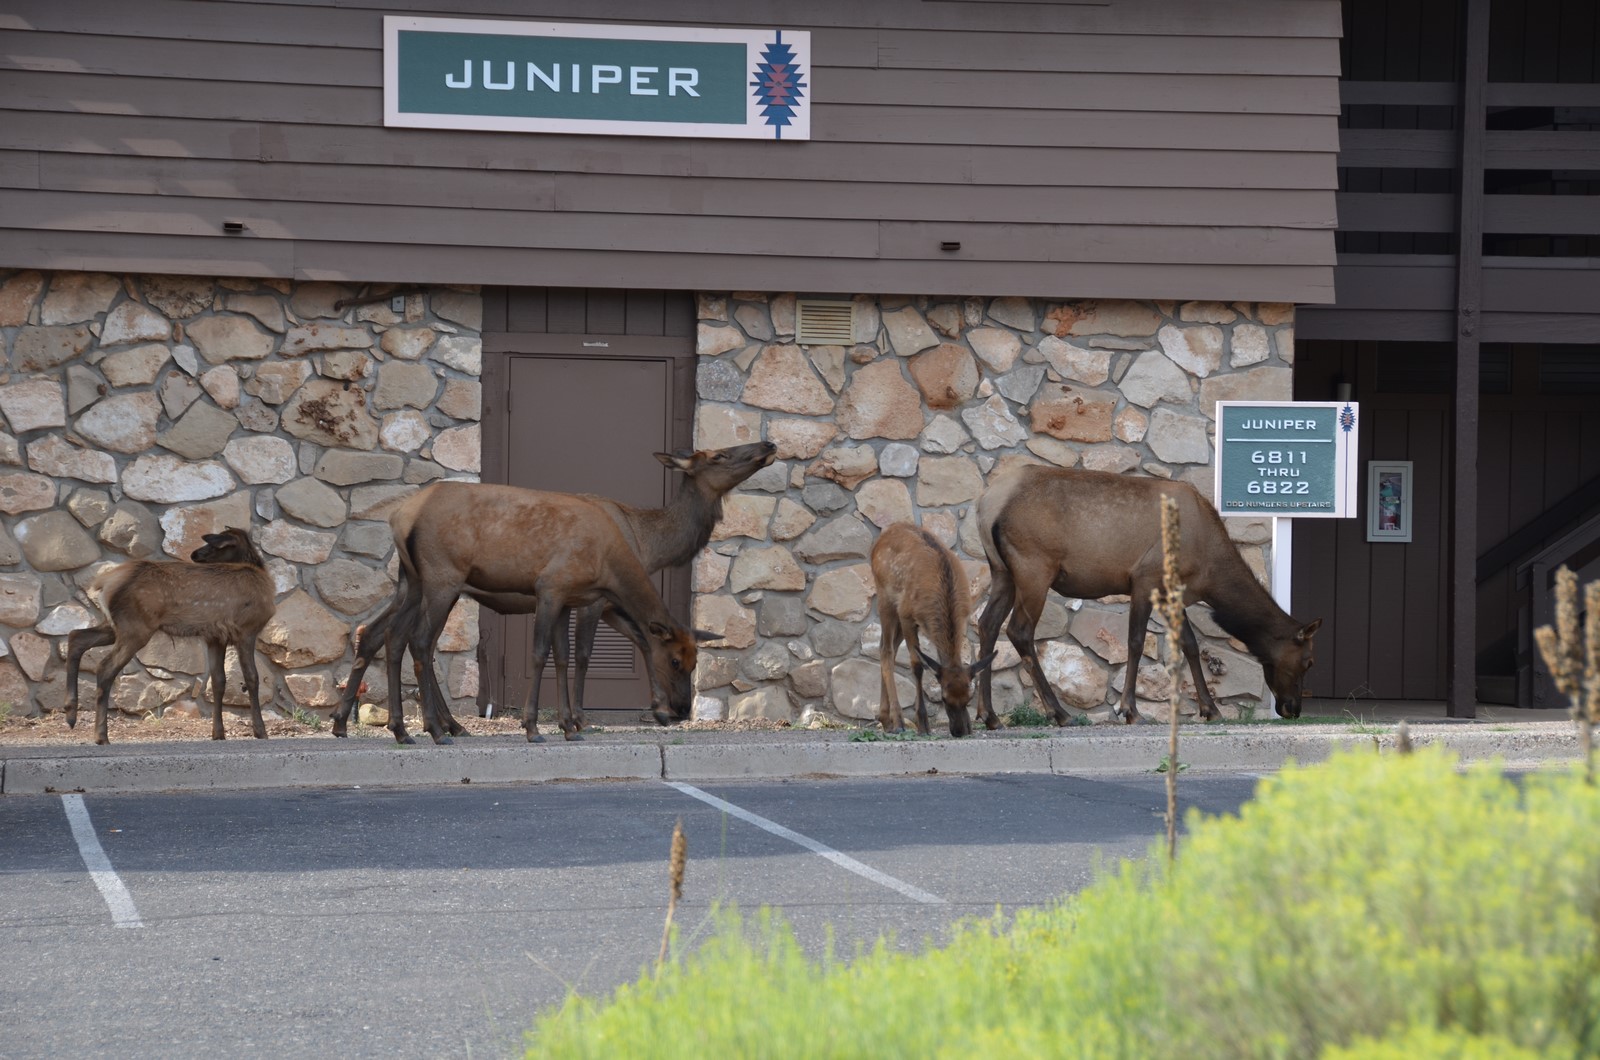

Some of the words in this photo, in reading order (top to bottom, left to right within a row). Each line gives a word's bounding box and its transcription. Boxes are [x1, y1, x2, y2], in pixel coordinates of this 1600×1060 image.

[445, 59, 700, 97] JUNIPER
[1241, 419, 1316, 430] JUNIPER
[1251, 451, 1307, 464] 6811
[1257, 467, 1300, 477] THRU
[1247, 481, 1309, 494] 6822
